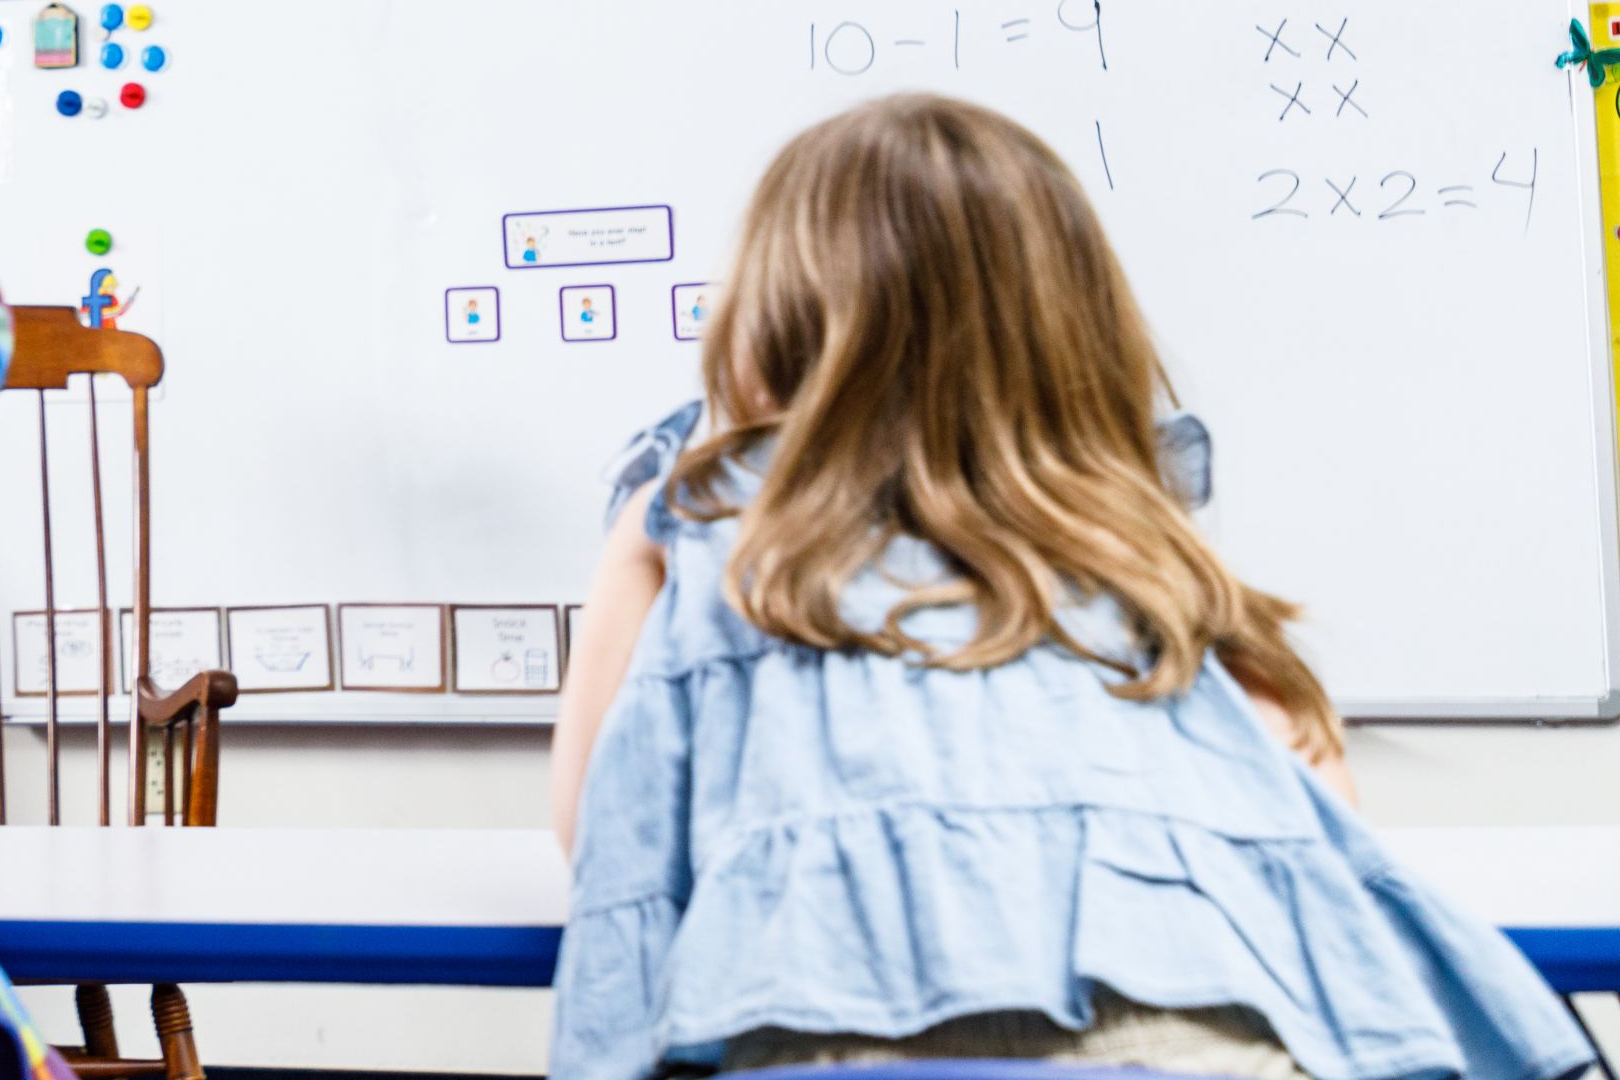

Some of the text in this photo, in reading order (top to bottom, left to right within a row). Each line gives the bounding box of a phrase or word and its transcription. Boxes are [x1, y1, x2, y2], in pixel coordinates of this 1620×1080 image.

[811, 21, 875, 76] 10
[1252, 169, 1309, 220] 2
[1378, 170, 1426, 220] 2
[1492, 146, 1538, 239] 4
